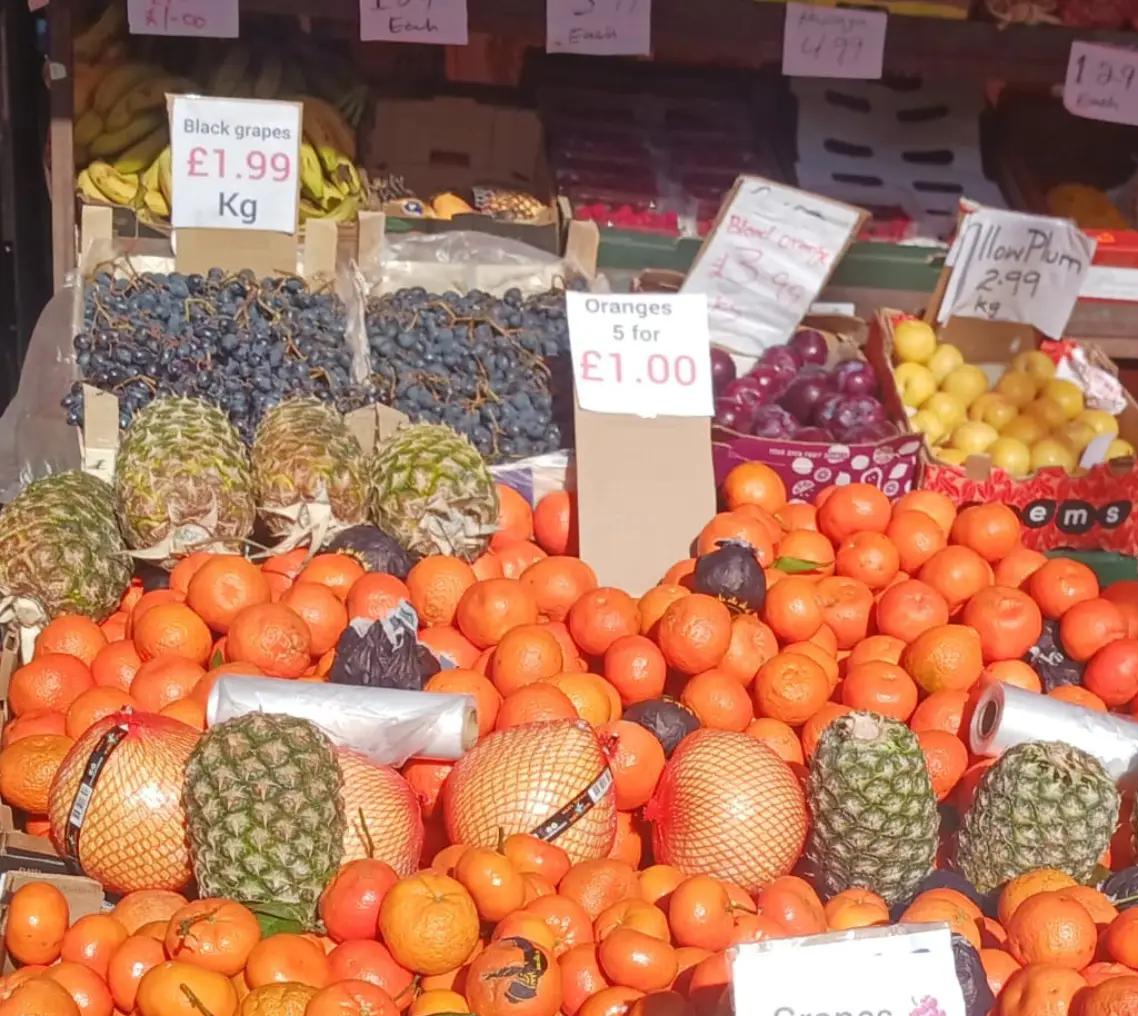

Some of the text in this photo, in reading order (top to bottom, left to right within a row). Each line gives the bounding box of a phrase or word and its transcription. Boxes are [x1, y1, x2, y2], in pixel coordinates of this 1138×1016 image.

[183, 118, 292, 141] Black grapes
[187, 146, 292, 182] £1.99
[218, 191, 258, 225] Kg
[975, 268, 1041, 299] 2.99
[584, 298, 673, 318] Oranges
[612, 324, 661, 342] 5 for
[579, 349, 697, 386] £1.00
